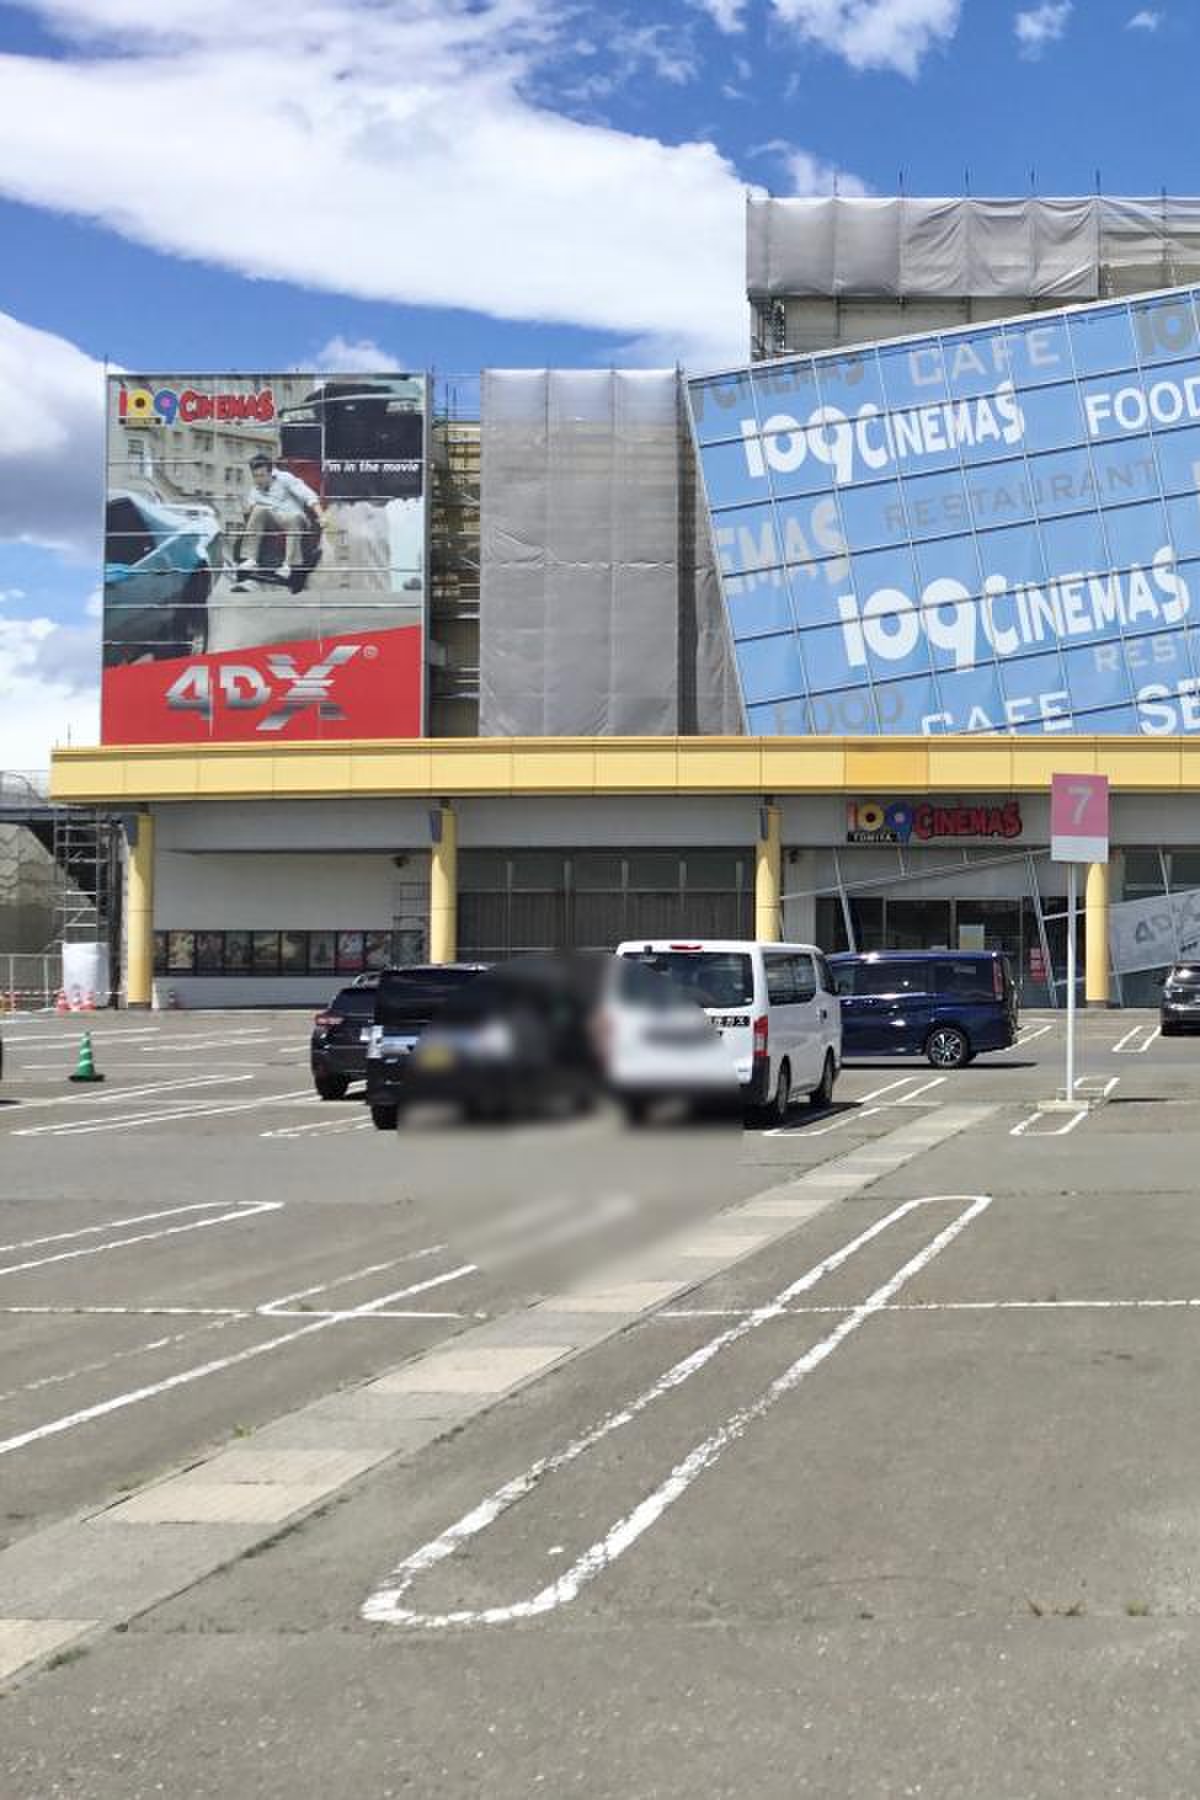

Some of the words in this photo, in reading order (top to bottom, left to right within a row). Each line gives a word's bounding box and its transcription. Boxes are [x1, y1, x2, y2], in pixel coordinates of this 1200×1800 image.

[909, 328, 1060, 386] CAFE
[855, 379, 1025, 469] CINEMAS
[359, 460, 379, 473] the
[382, 462, 419, 473] movie
[884, 458, 1157, 533] RESTAURANT
[979, 545, 1191, 655] CINEMAS
[164, 644, 361, 732] 4DX
[1066, 786, 1092, 825] 7
